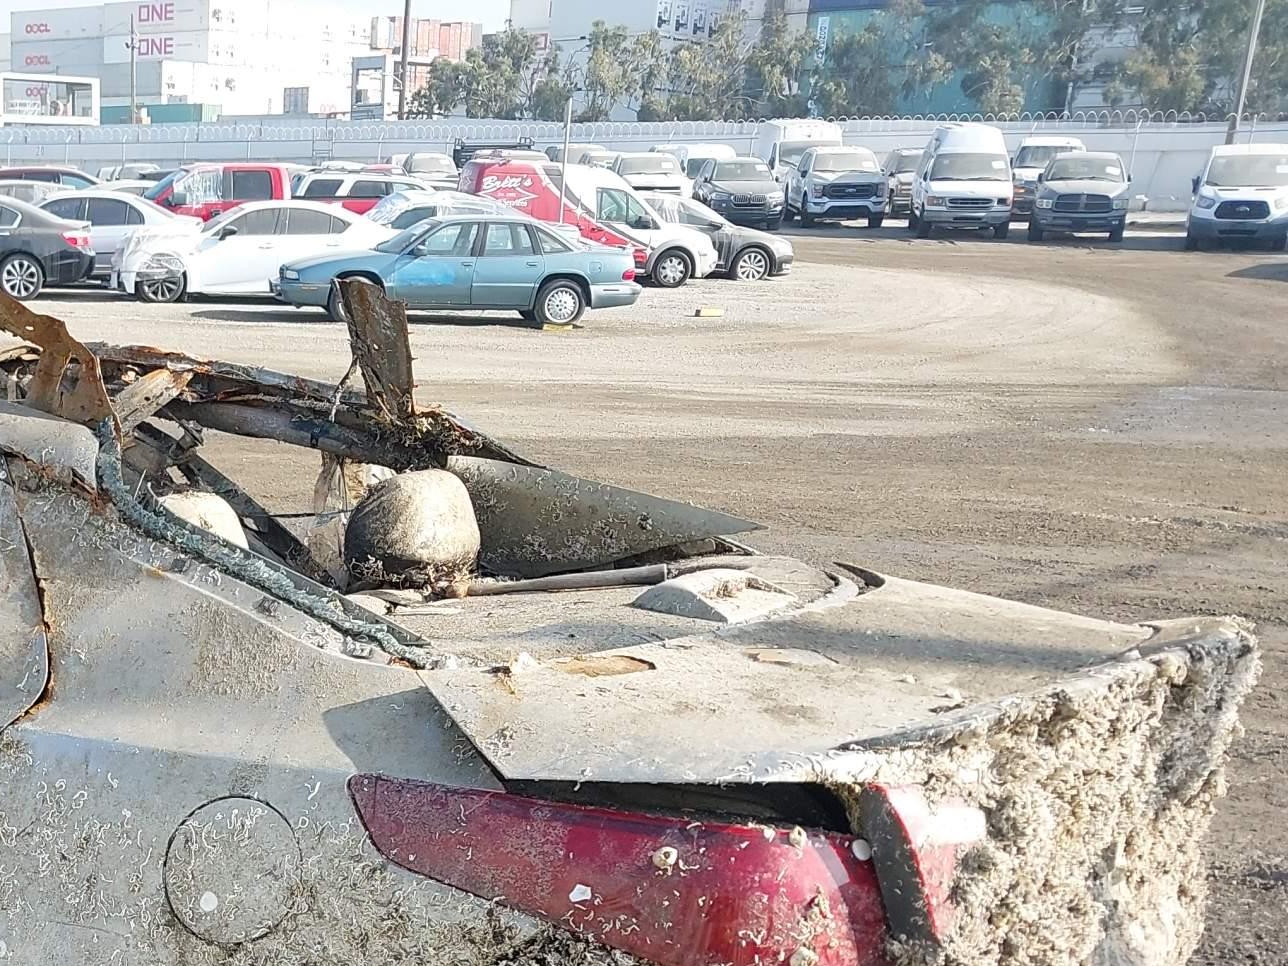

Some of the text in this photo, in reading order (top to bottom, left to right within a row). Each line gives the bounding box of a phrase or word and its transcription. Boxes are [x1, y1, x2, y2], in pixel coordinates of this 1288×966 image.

[138, 3, 175, 22] ONE
[25, 23, 51, 34] OOCL
[138, 37, 174, 56] ONE
[25, 55, 51, 66] OOCL
